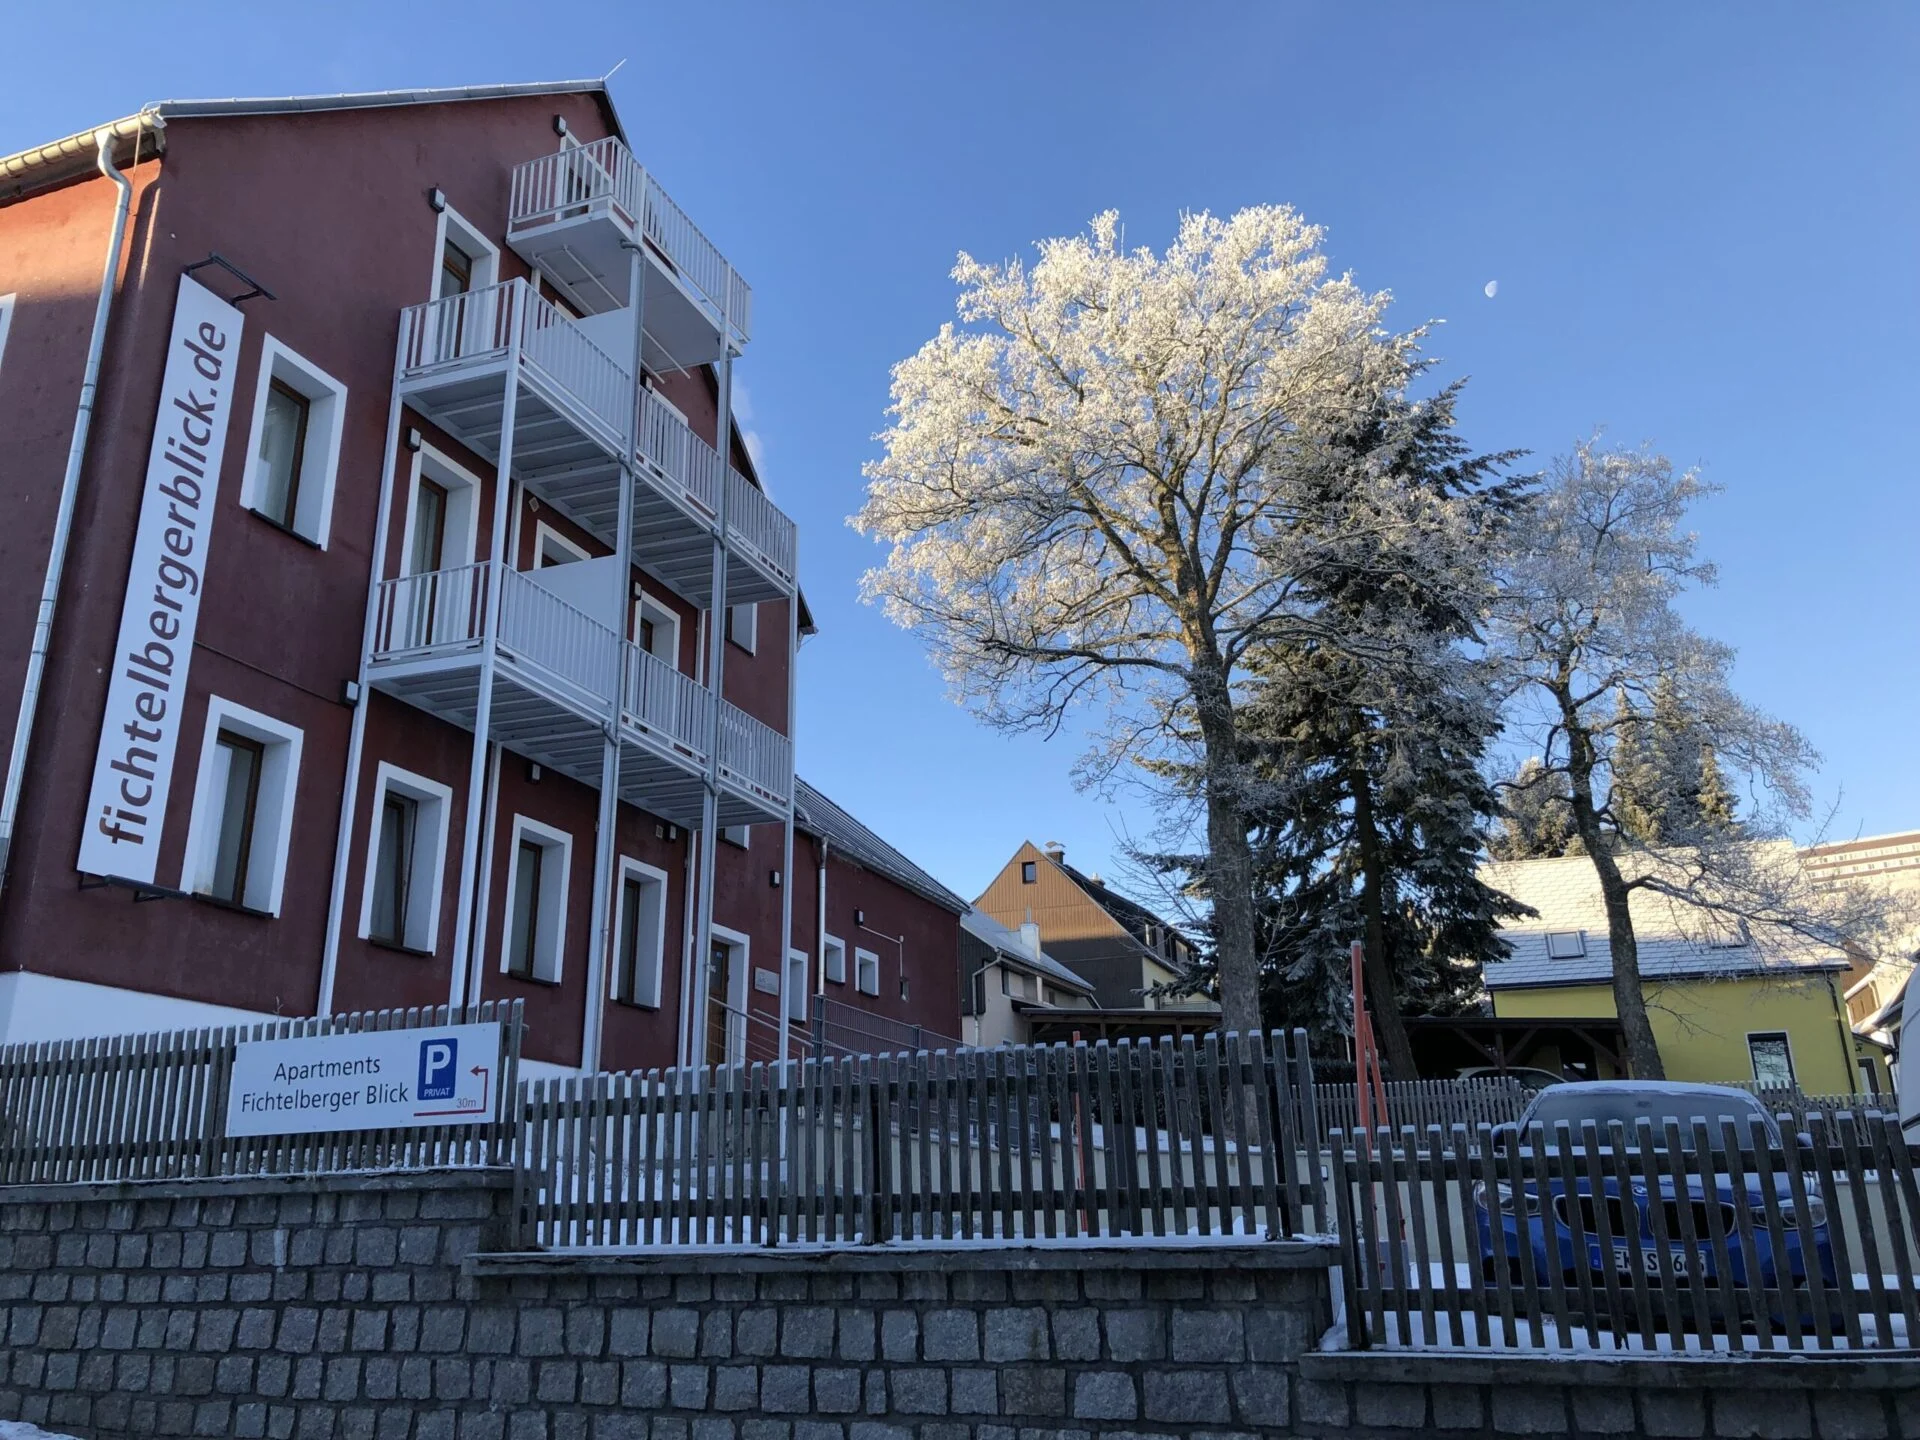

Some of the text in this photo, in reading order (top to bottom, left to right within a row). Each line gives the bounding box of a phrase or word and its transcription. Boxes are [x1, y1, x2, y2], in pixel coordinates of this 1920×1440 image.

[99, 320, 227, 845] fichtelbergerblick.de
[273, 1056, 381, 1085] Apartments
[425, 1044, 451, 1085] P
[241, 1082, 409, 1112] Fichtelberger Blick
[423, 1087, 450, 1098] PRIVAT
[456, 1097, 477, 1109] 30m
